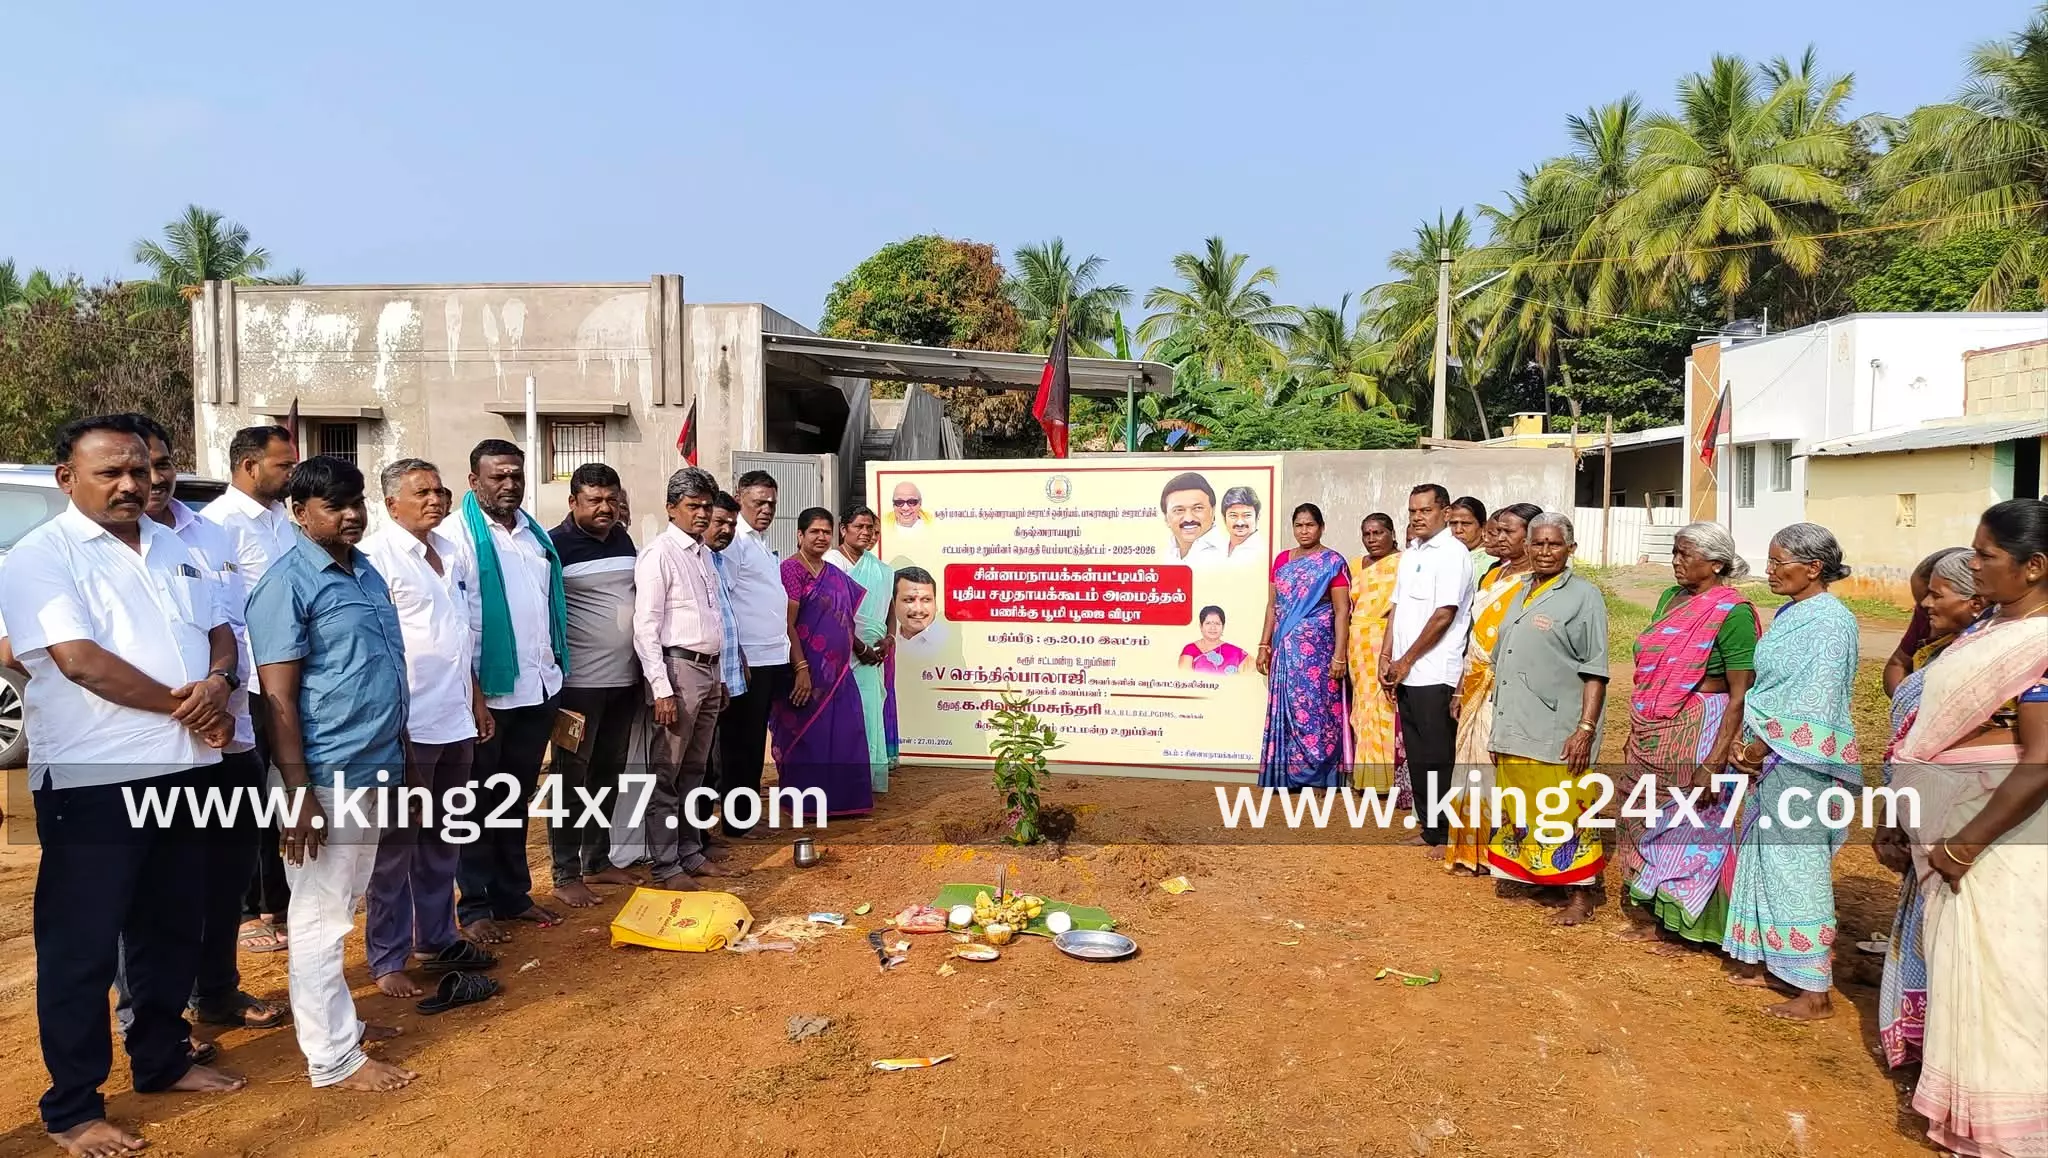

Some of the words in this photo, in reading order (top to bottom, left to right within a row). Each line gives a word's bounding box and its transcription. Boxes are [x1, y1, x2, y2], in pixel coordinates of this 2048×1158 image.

[1112, 545, 1156, 555] 2025-2026
[974, 566, 1159, 585] சின்னமநாயக்கன்பட்டியில்
[953, 585, 986, 602] புதிய
[989, 586, 1099, 603] சமுதாயக்கூடம்
[1102, 587, 1187, 605] அமைத்தல்
[990, 605, 1039, 619] பணிக்கு
[1041, 605, 1066, 622] பூமி
[1069, 609, 1105, 623] பூஜை
[1108, 607, 1142, 622] விழா
[988, 632, 1034, 644] மதிப்பீடு
[1098, 635, 1150, 646] இலட்சம்
[950, 665, 1087, 685] செந்தில்பாலாஜி
[1059, 723, 1108, 735] சட்டமன்ற
[1111, 726, 1163, 737] உறுப்பினர்
